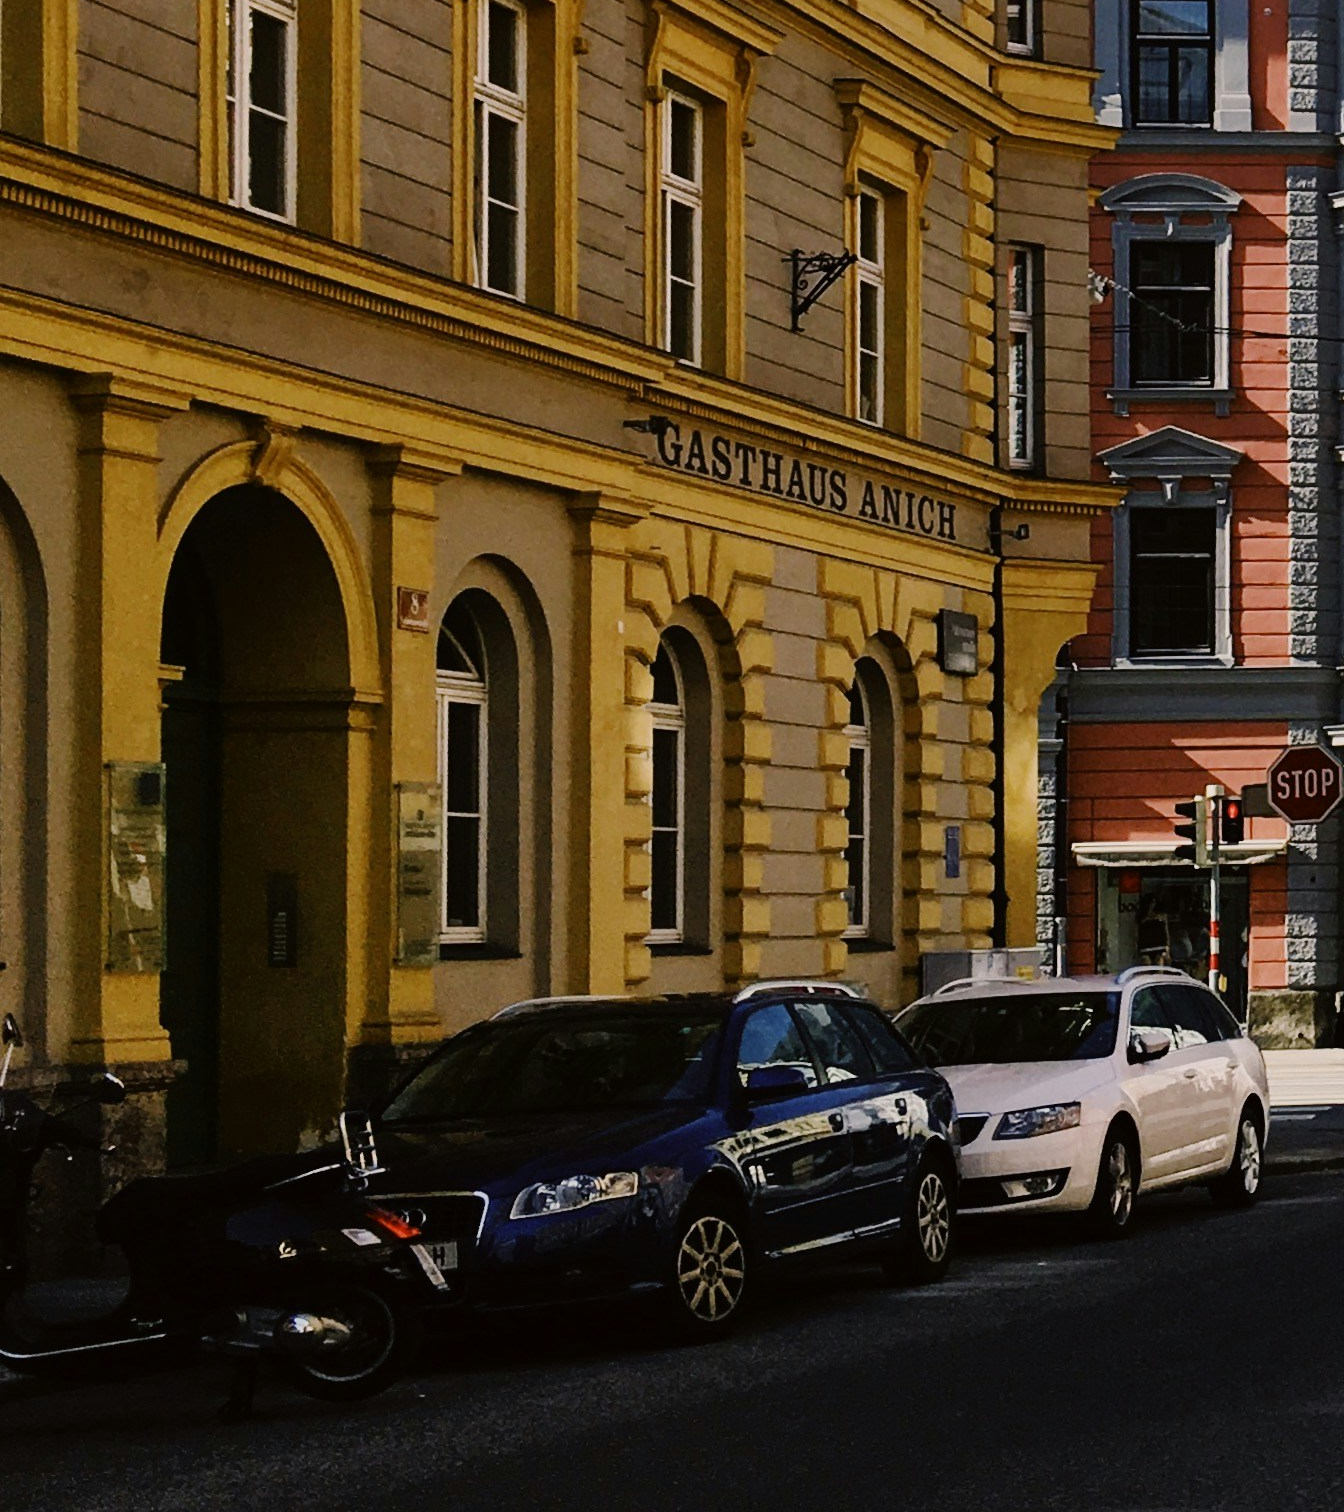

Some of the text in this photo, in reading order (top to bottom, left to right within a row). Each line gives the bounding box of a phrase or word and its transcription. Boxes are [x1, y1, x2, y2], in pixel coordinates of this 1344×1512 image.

[656, 423, 957, 541] GASTHAUS ANICH
[1277, 768, 1334, 799] STOP
